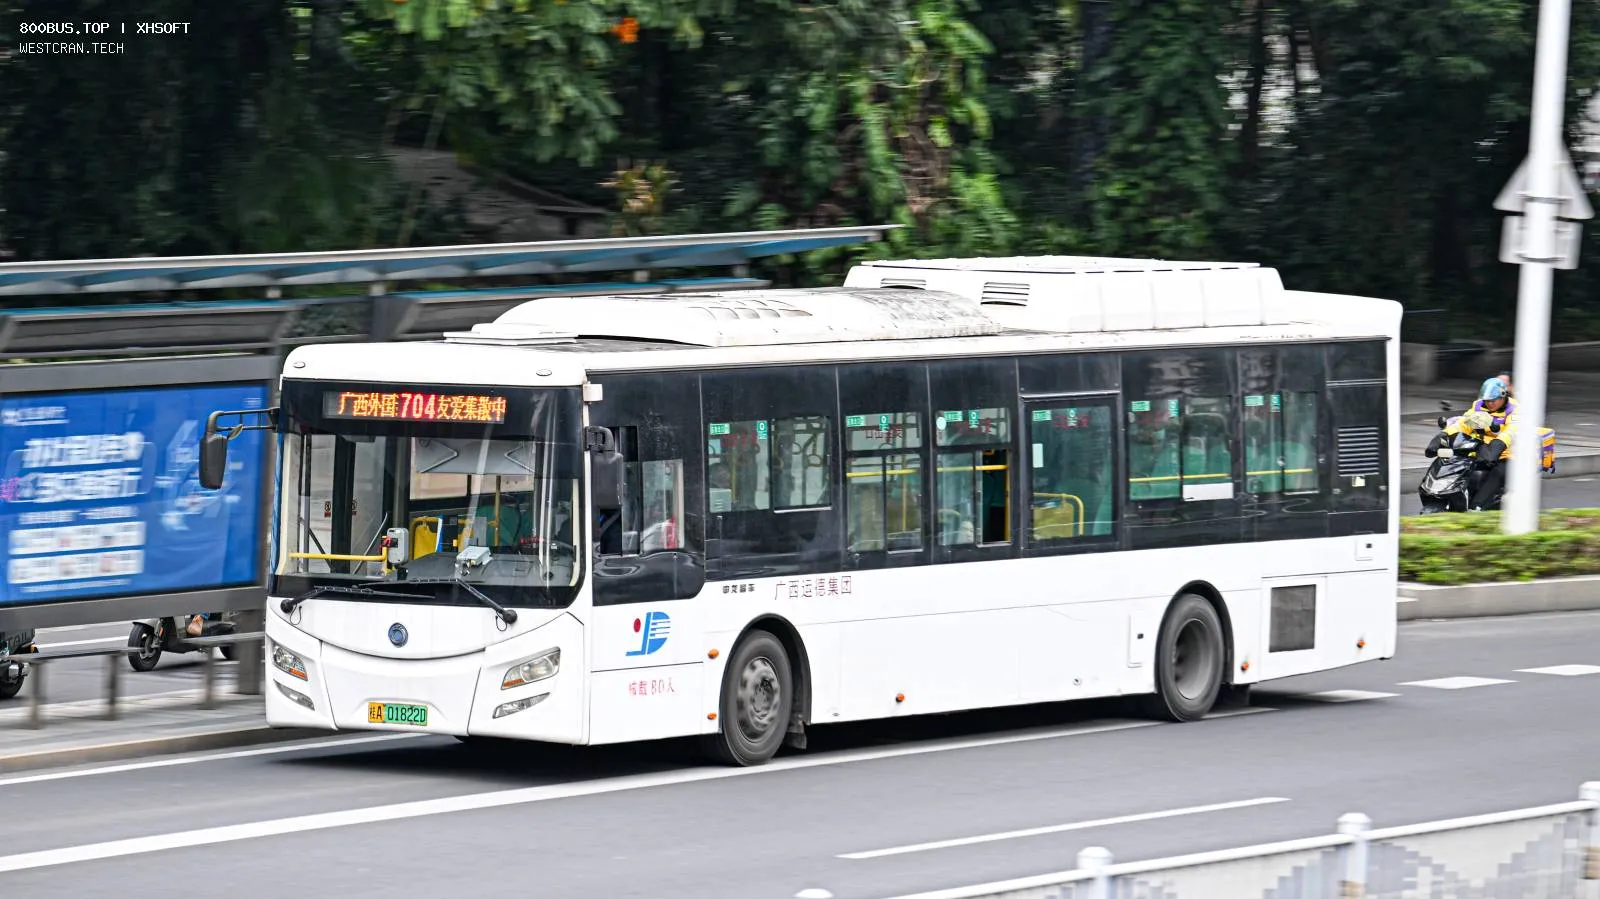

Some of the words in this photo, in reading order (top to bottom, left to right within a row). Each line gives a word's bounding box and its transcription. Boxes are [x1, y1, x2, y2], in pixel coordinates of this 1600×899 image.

[338, 392, 398, 417] 广西外国
[401, 394, 436, 419] 704
[774, 575, 852, 601] 广西运德集团
